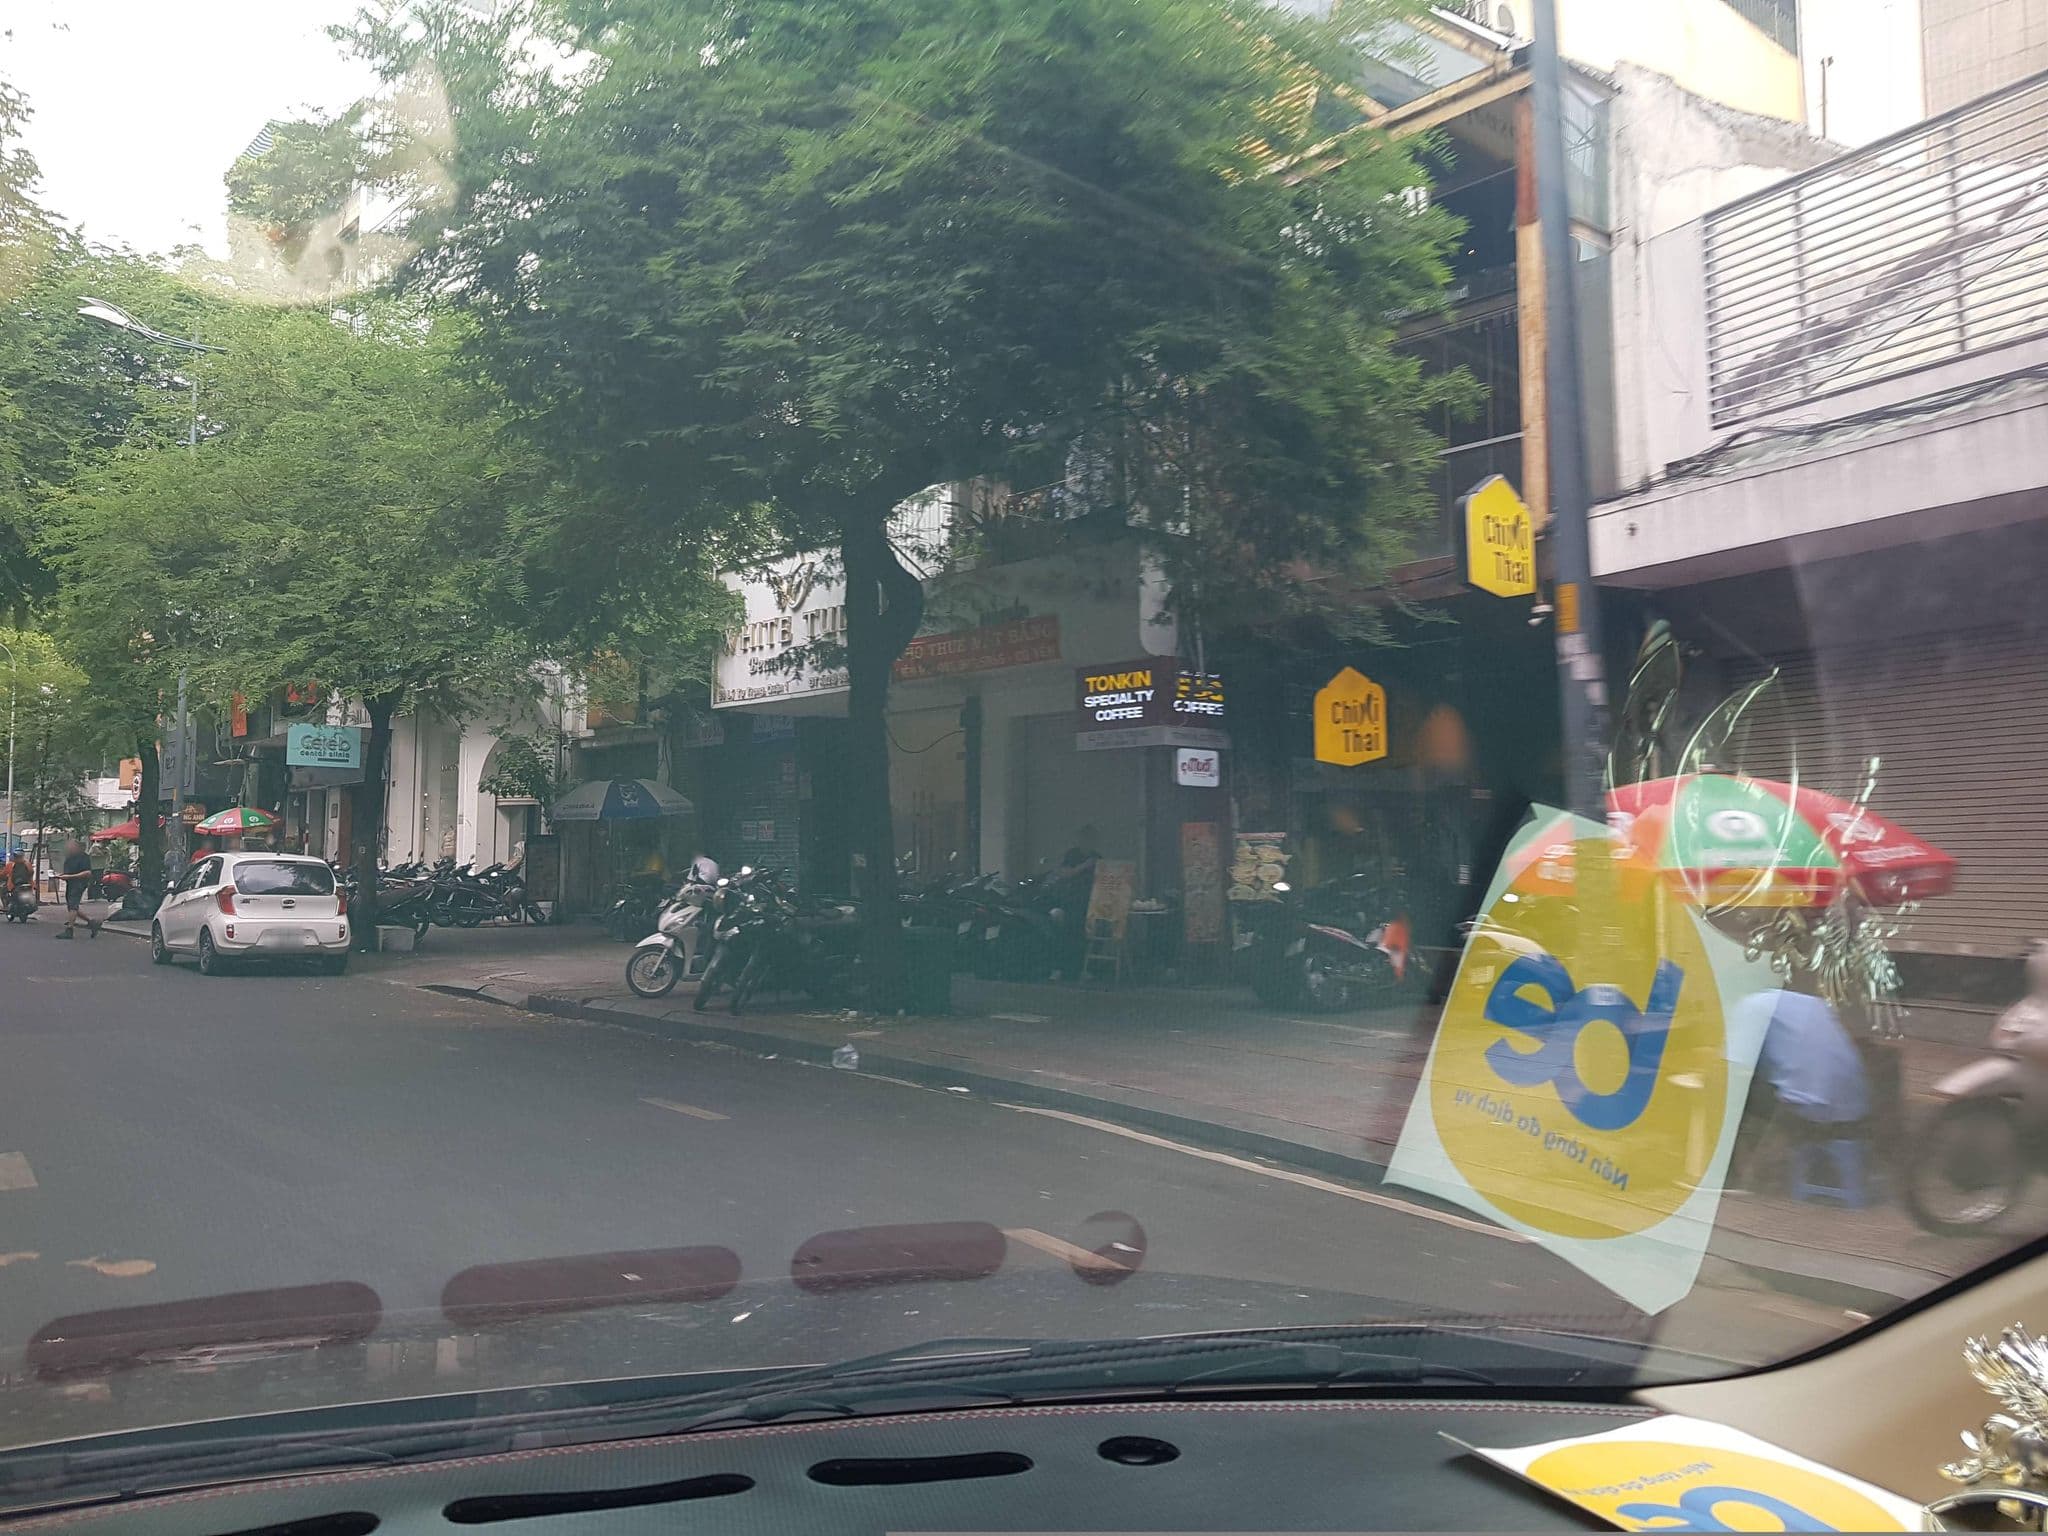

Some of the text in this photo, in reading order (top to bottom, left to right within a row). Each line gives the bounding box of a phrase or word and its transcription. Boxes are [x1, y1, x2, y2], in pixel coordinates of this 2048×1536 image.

[722, 615, 793, 656] WHITE
[1084, 670, 1152, 693] TONKIN
[1083, 689, 1155, 708] SPECIALTY
[1095, 706, 1144, 722] COFFEE
[1341, 726, 1380, 753] Thai
